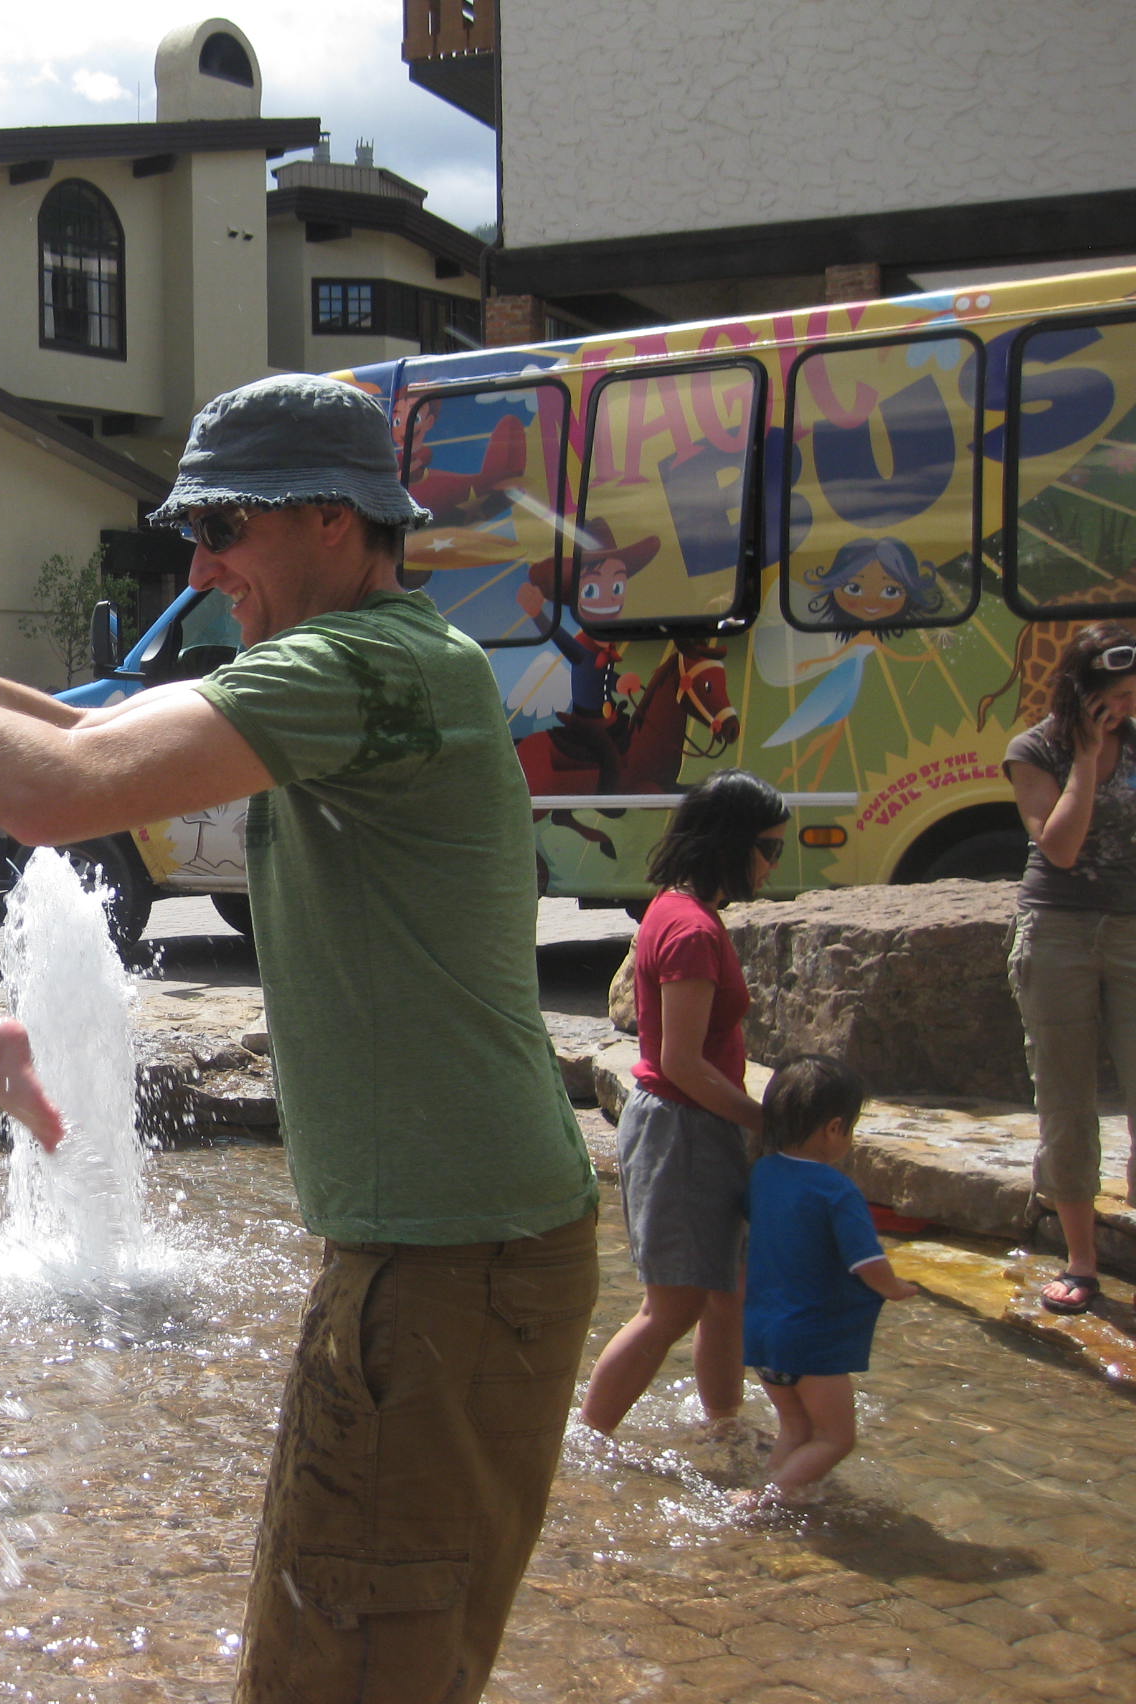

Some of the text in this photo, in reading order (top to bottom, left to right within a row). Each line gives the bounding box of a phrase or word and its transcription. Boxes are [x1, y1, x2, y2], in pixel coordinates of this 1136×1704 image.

[536, 303, 879, 514] MAGIC
[657, 322, 1116, 577] BUS
[856, 751, 978, 831] POWERED BY THE
[875, 764, 1011, 825] VAIL VALLE
